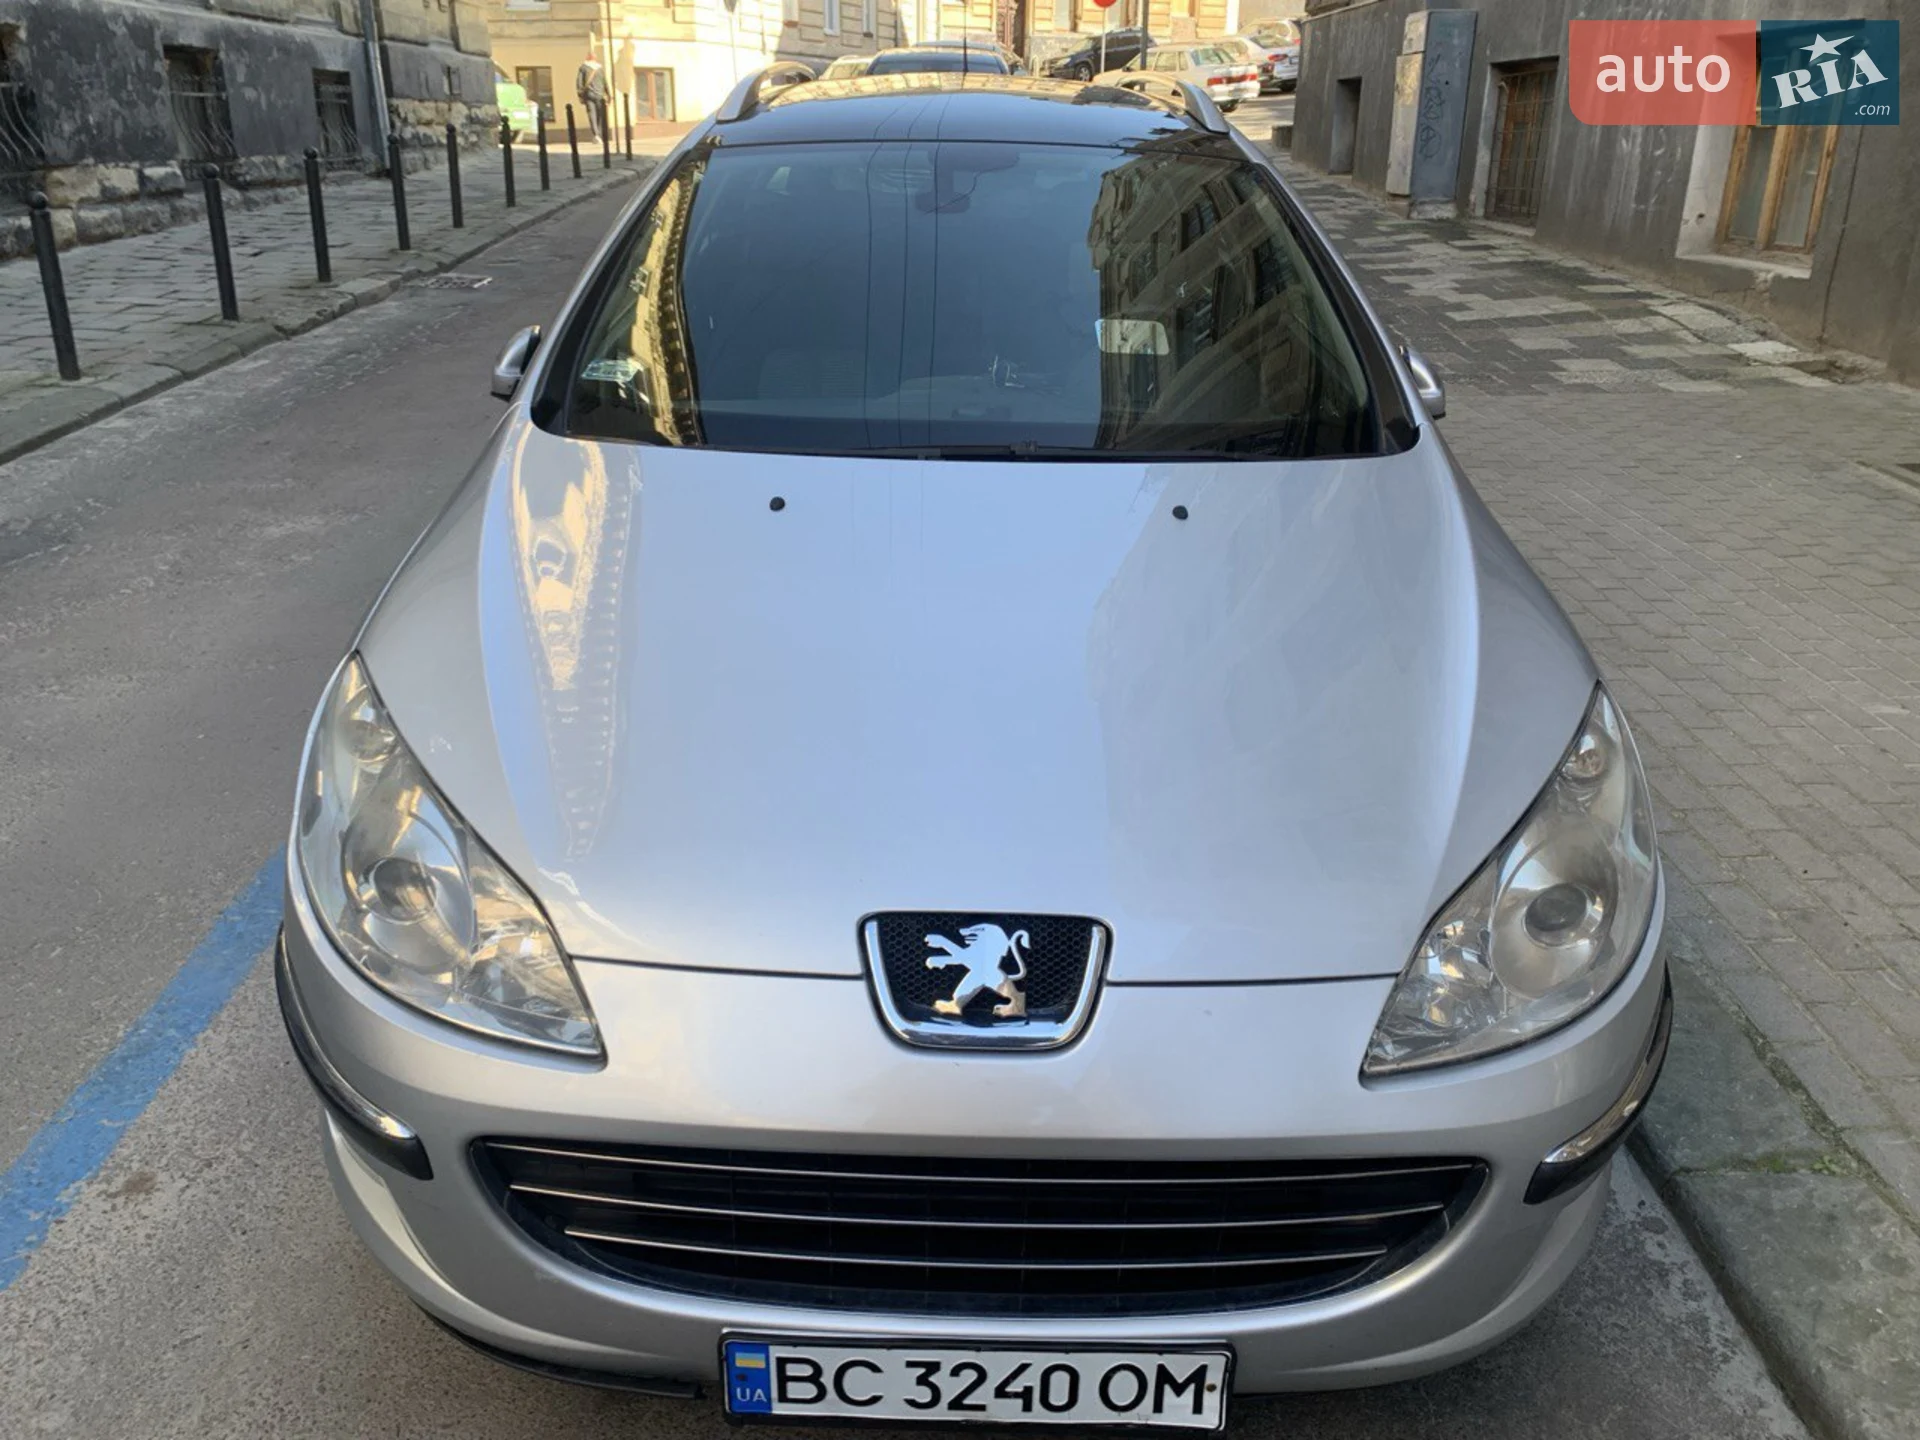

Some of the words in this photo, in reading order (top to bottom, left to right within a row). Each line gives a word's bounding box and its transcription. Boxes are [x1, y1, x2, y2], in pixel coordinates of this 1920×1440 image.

[736, 1386, 767, 1403] UA
[775, 1355, 884, 1407] BC
[904, 1360, 1079, 1412] 3240
[1098, 1362, 1208, 1415] OM
